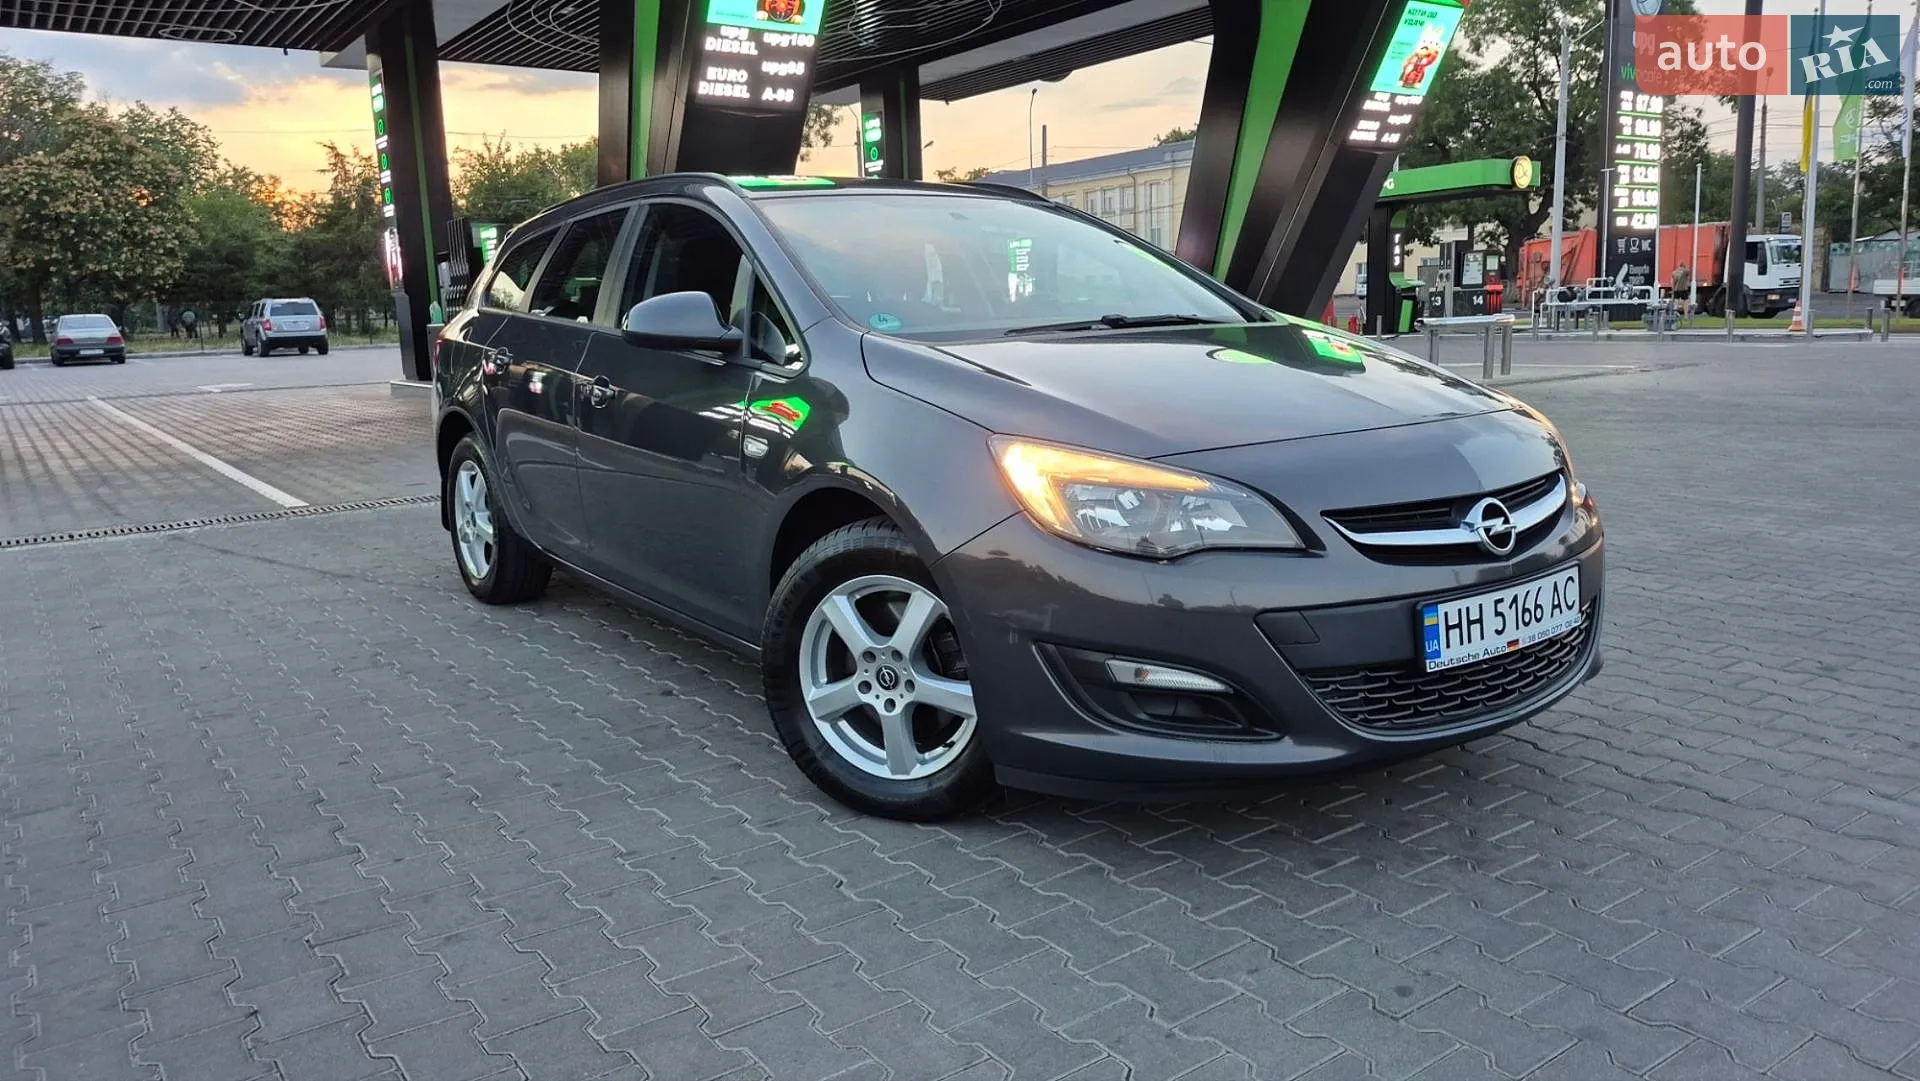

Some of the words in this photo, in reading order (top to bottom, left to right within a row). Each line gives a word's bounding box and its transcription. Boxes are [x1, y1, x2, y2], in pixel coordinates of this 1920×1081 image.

[705, 37, 758, 55] DIESEL
[707, 67, 748, 82] EURO
[698, 81, 750, 98] DIESEL
[1472, 295, 1483, 305] 14
[1444, 602, 1484, 649] HH
[1494, 586, 1544, 636] 5166
[1550, 576, 1575, 619] AC
[1425, 640, 1439, 653] UA
[1428, 651, 1480, 670] Deutsche
[1482, 645, 1506, 657] Auto
